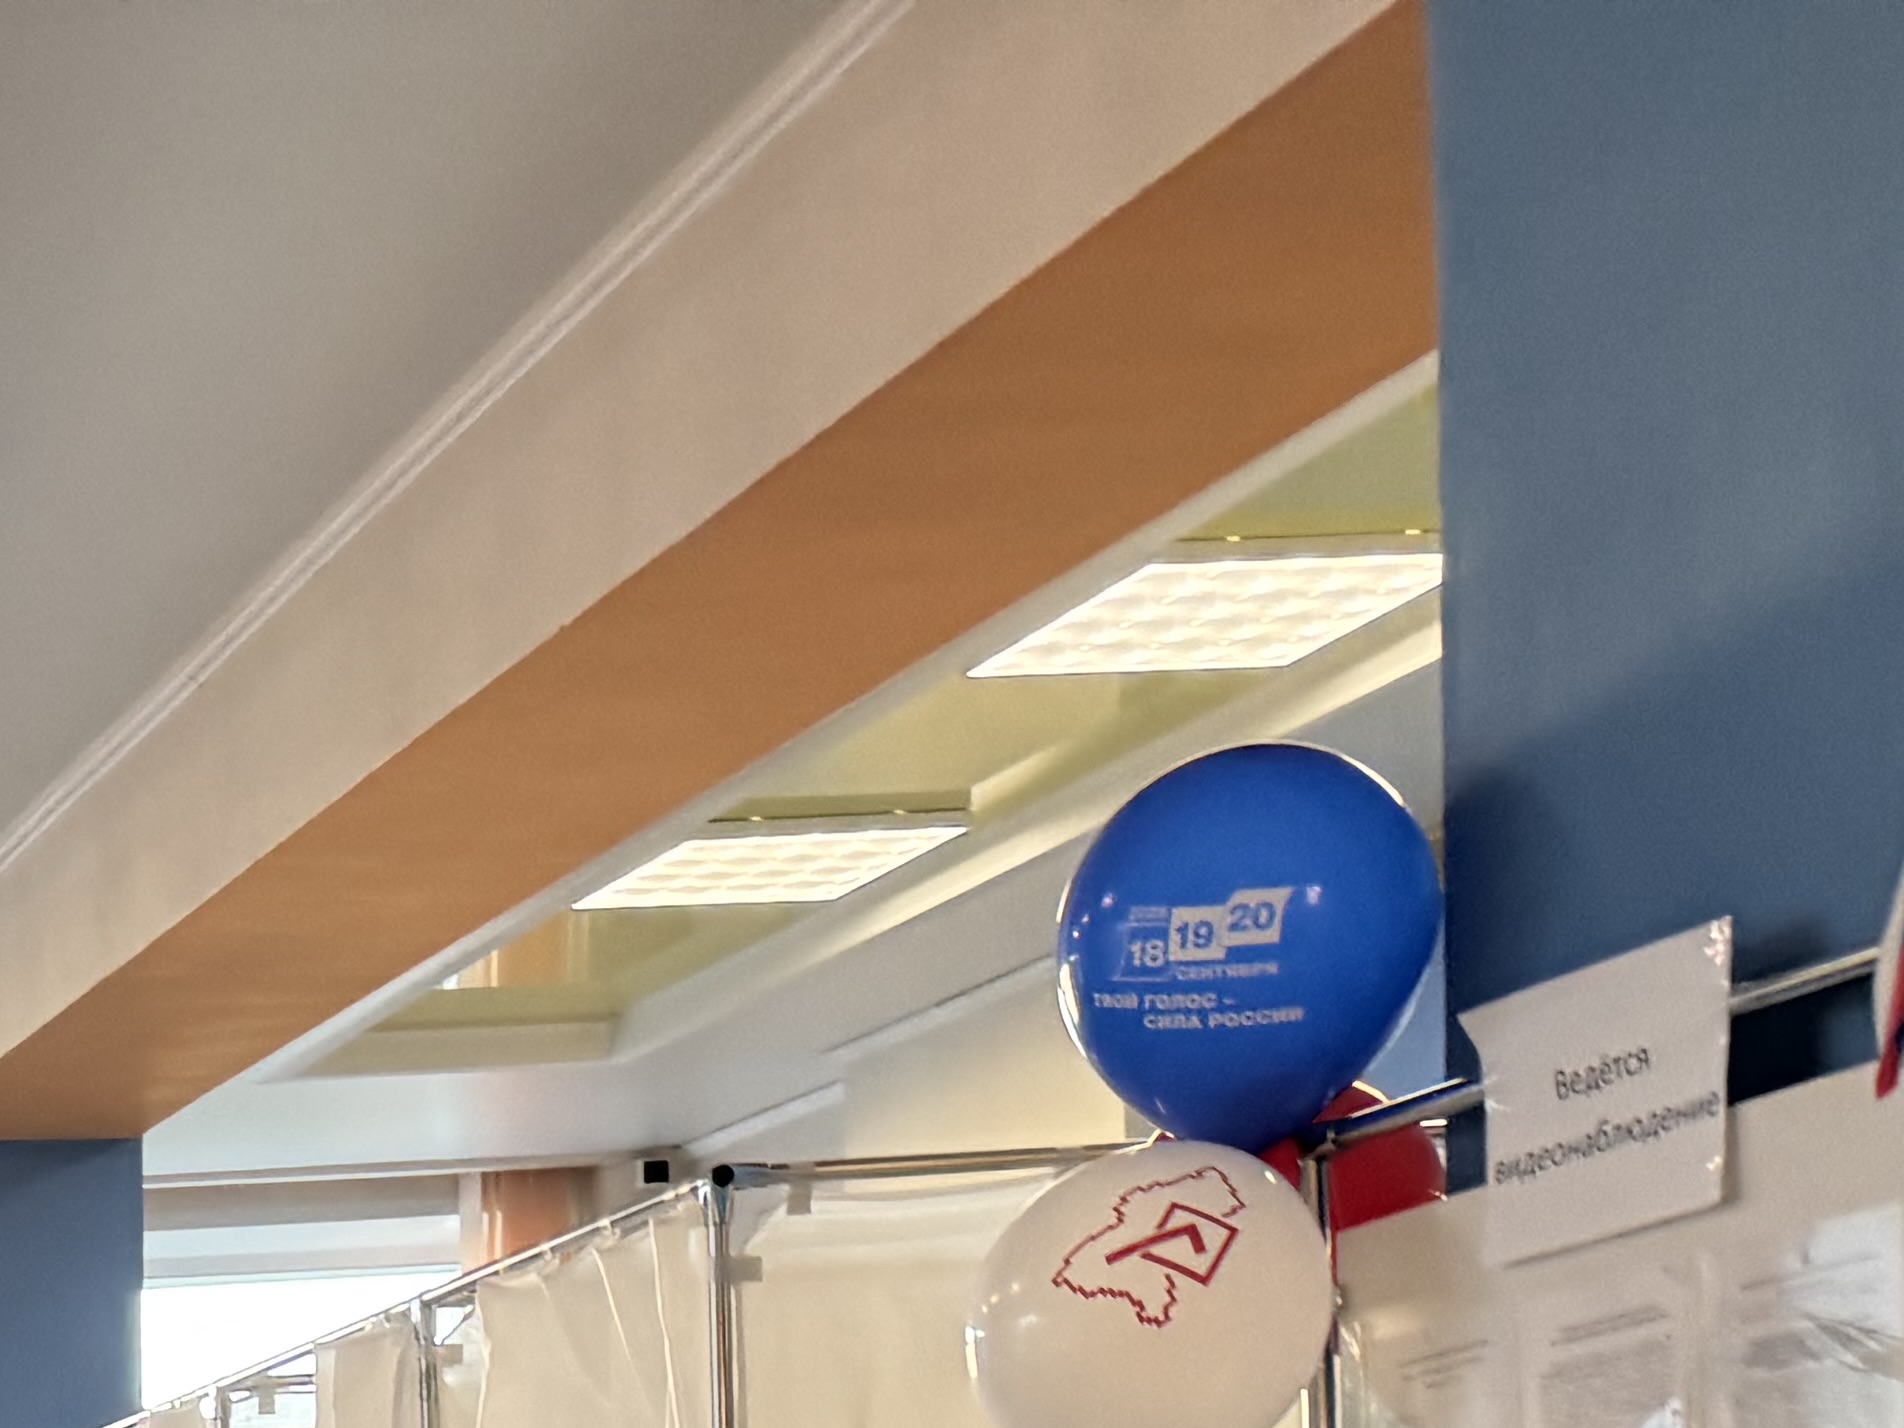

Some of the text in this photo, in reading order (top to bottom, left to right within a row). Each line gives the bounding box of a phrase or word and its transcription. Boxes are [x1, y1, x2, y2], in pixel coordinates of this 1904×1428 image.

[1129, 901, 1276, 968] 18 19 20
[1144, 993, 1218, 1010] ГОЛОС
[1143, 1007, 1305, 1029] СИЛА РОССИИ
